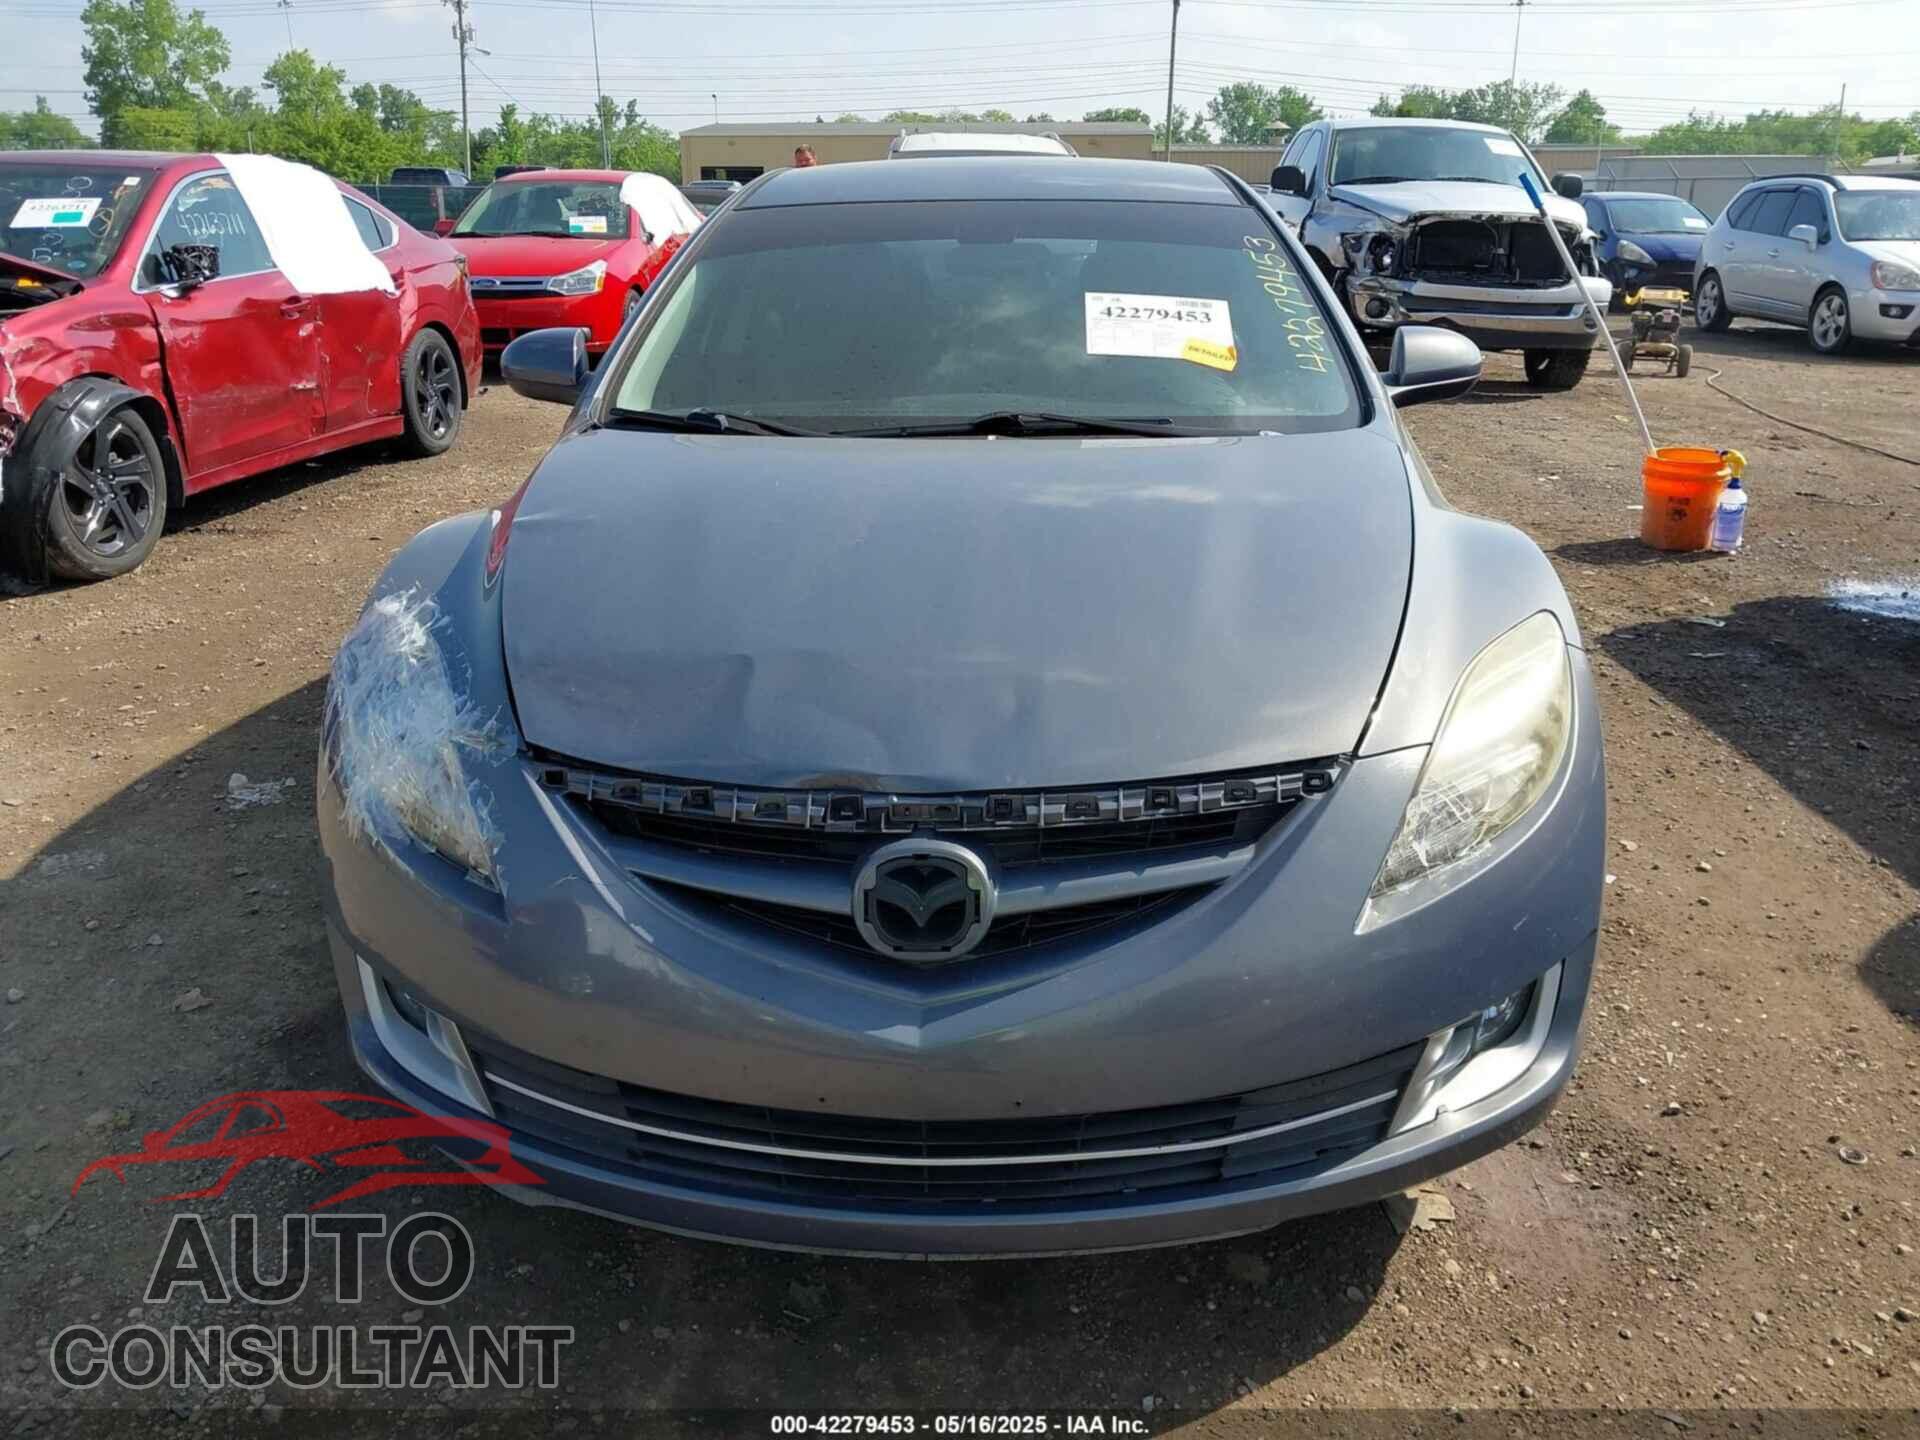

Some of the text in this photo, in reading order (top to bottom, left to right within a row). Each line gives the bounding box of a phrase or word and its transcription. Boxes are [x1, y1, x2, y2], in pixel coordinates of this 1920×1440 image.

[176, 212, 247, 237] 42263711
[1099, 305, 1213, 324] 42279453
[1243, 235, 1334, 373] 42279453
